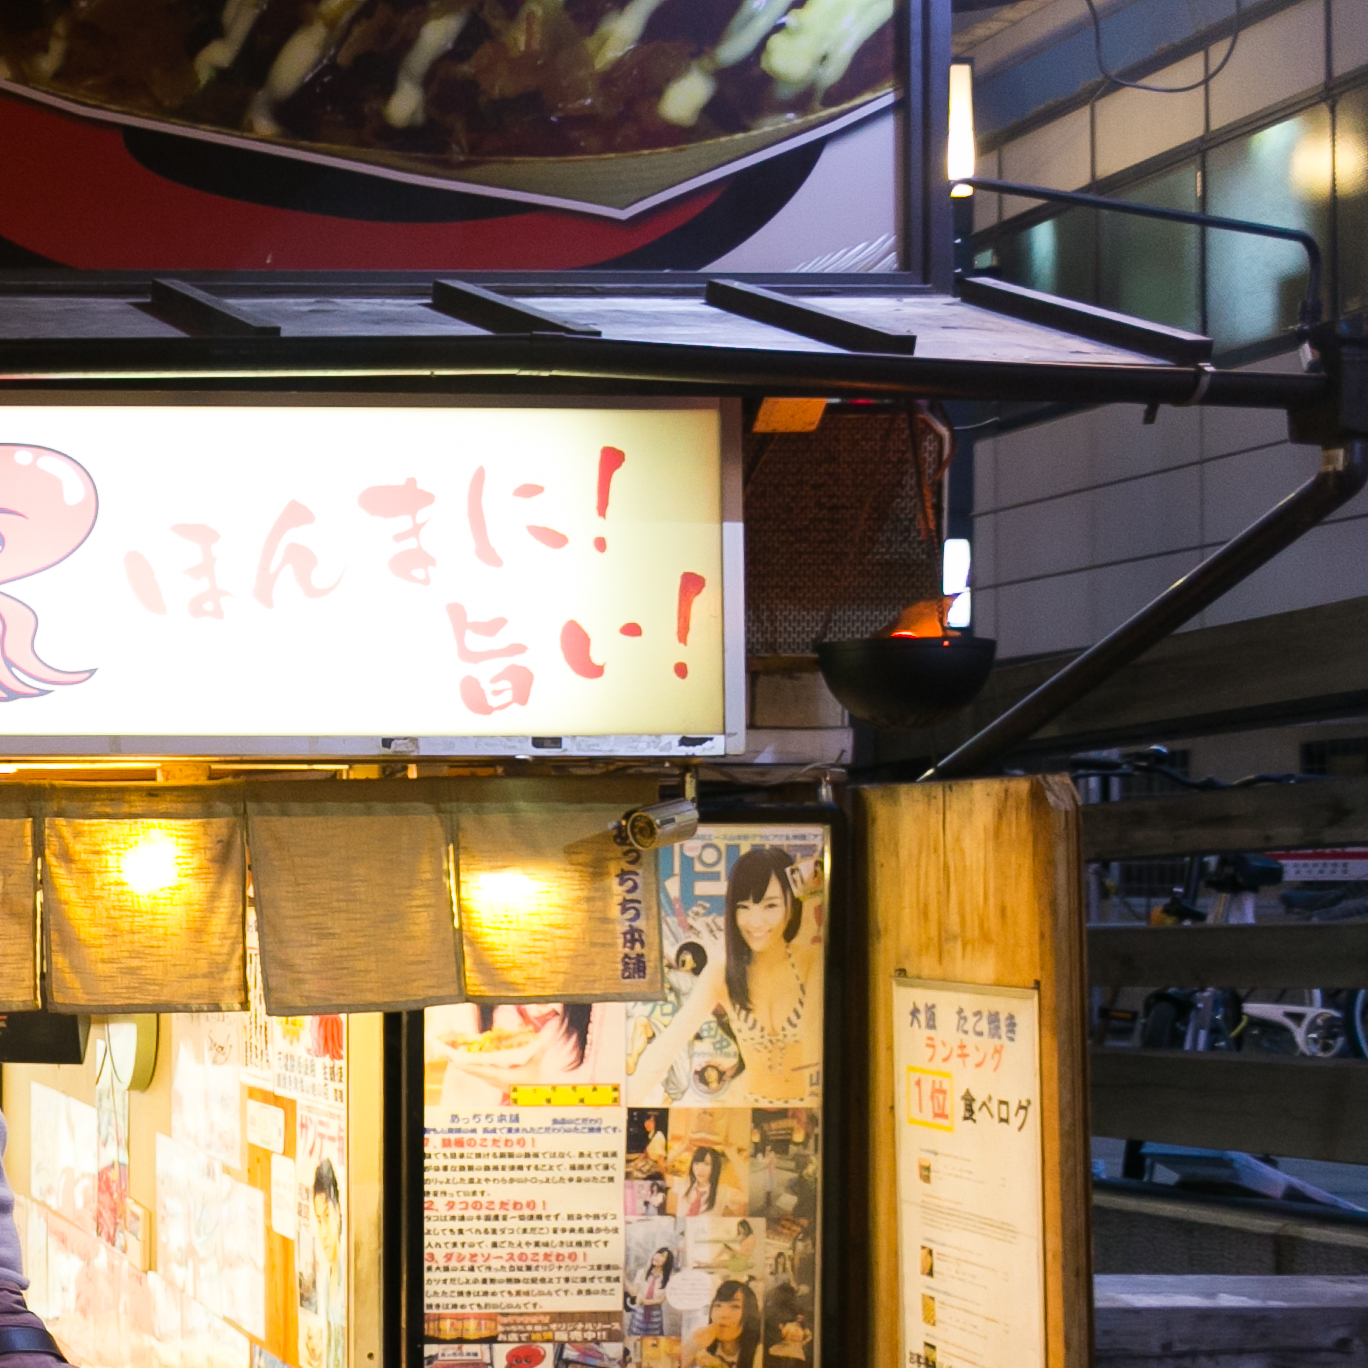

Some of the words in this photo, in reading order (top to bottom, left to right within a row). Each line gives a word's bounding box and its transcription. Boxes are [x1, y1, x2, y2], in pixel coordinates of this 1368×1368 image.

[124, 446, 625, 618] ほんまに！
[446, 571, 705, 715] 旨い！
[909, 1001, 937, 1031] 大阪
[956, 1005, 1017, 1042] たこ焼き
[925, 1036, 1004, 1072] ランキング
[914, 1077, 949, 1120] 1位
[961, 1087, 1032, 1132] 食べログ
